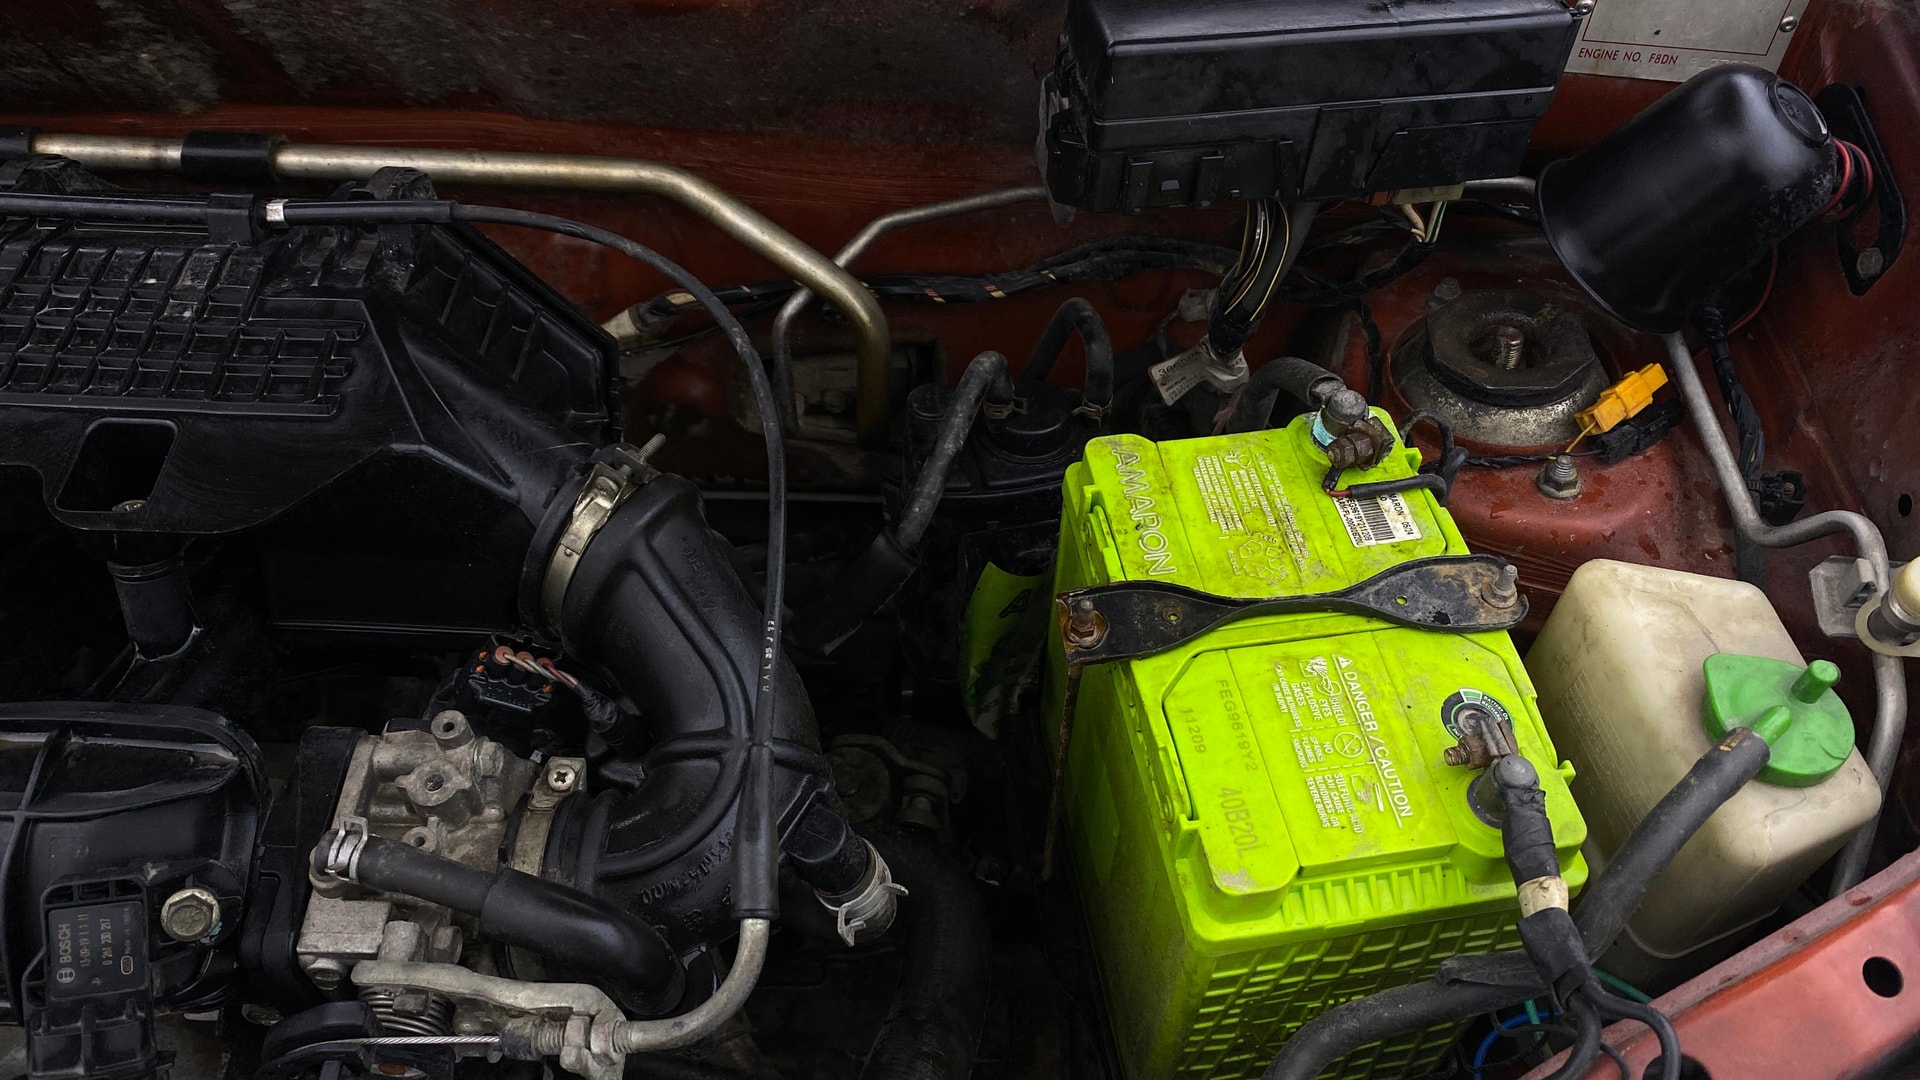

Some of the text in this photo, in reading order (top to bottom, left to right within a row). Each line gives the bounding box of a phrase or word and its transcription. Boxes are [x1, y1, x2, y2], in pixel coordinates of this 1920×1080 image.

[1578, 47, 1618, 61] ENGINE
[1623, 52, 1642, 63] NO.
[1648, 53, 1678, 65] F8DN
[1112, 449, 1177, 576] AMARON
[1389, 493, 1405, 516] MARON
[1291, 682, 1306, 707] GASES
[1301, 681, 1323, 721] EXPLOSIVE
[1319, 699, 1332, 717] EYES
[1483, 695, 1504, 712] BATTERY
[1182, 707, 1207, 754] 11209
[1216, 679, 1258, 772] FEG9619Y2
[1344, 671, 1379, 732] DANGER
[1374, 746, 1414, 817] CAUTION
[1293, 739, 1308, 768] SMOKING
[1324, 741, 1334, 754] NO
[1306, 777, 1331, 828] SEVERE BURNS
[1315, 775, 1335, 814] BLINDNESS
[1324, 774, 1345, 814] CAN CAUSE
[1333, 772, 1354, 813] SULFURIC
[1219, 787, 1261, 859] 40B20L
[58, 923, 72, 964] BOSCH
